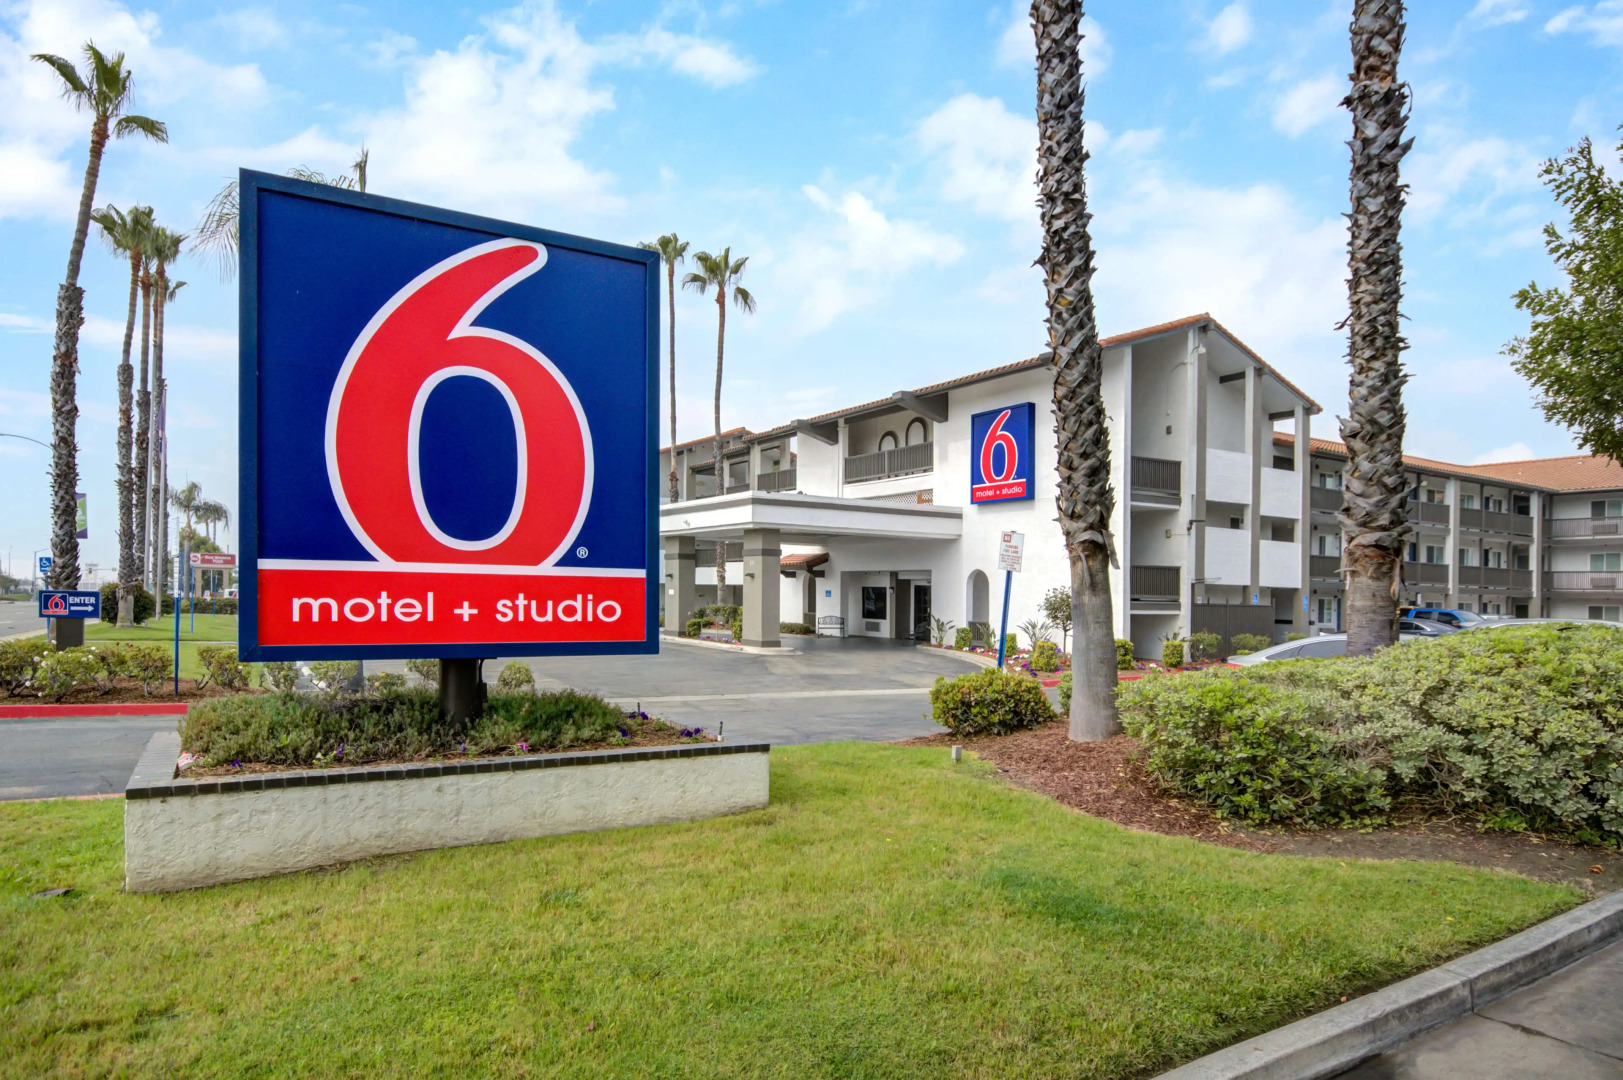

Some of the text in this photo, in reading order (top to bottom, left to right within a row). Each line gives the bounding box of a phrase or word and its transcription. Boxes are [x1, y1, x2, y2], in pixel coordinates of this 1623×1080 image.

[325, 236, 595, 567] 6
[980, 409, 1018, 484] 6
[976, 489, 994, 498] motel
[1001, 485, 1023, 495] studio
[47, 593, 65, 611] 6
[69, 596, 96, 604] ENTER
[292, 591, 622, 622] motel + studio
